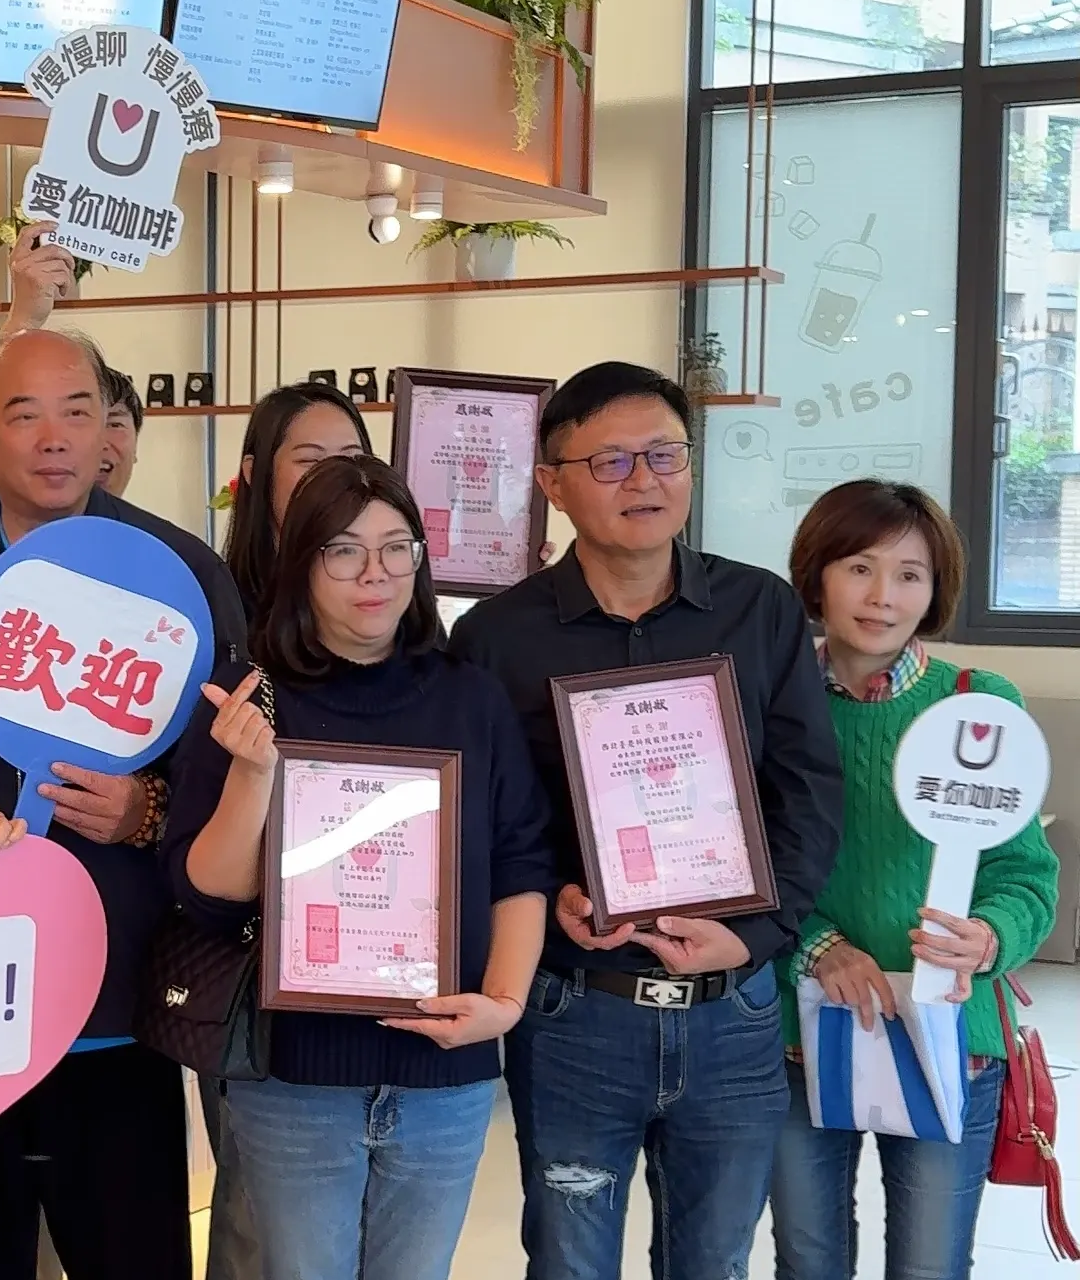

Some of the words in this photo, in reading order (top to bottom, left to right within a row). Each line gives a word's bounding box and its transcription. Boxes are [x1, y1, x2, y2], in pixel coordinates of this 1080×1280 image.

[31, 31, 127, 100] 慢慢聊
[142, 43, 214, 145] 慢慢療
[28, 173, 177, 250] 愛你咖啡
[48, 231, 105, 258] Bethany
[110, 249, 141, 267] cafe
[455, 403, 493, 417] 感謝狀
[624, 698, 668, 716] 感謝狀
[339, 778, 386, 794] 感謝狀
[914, 775, 1023, 813] 愛你咖啡
